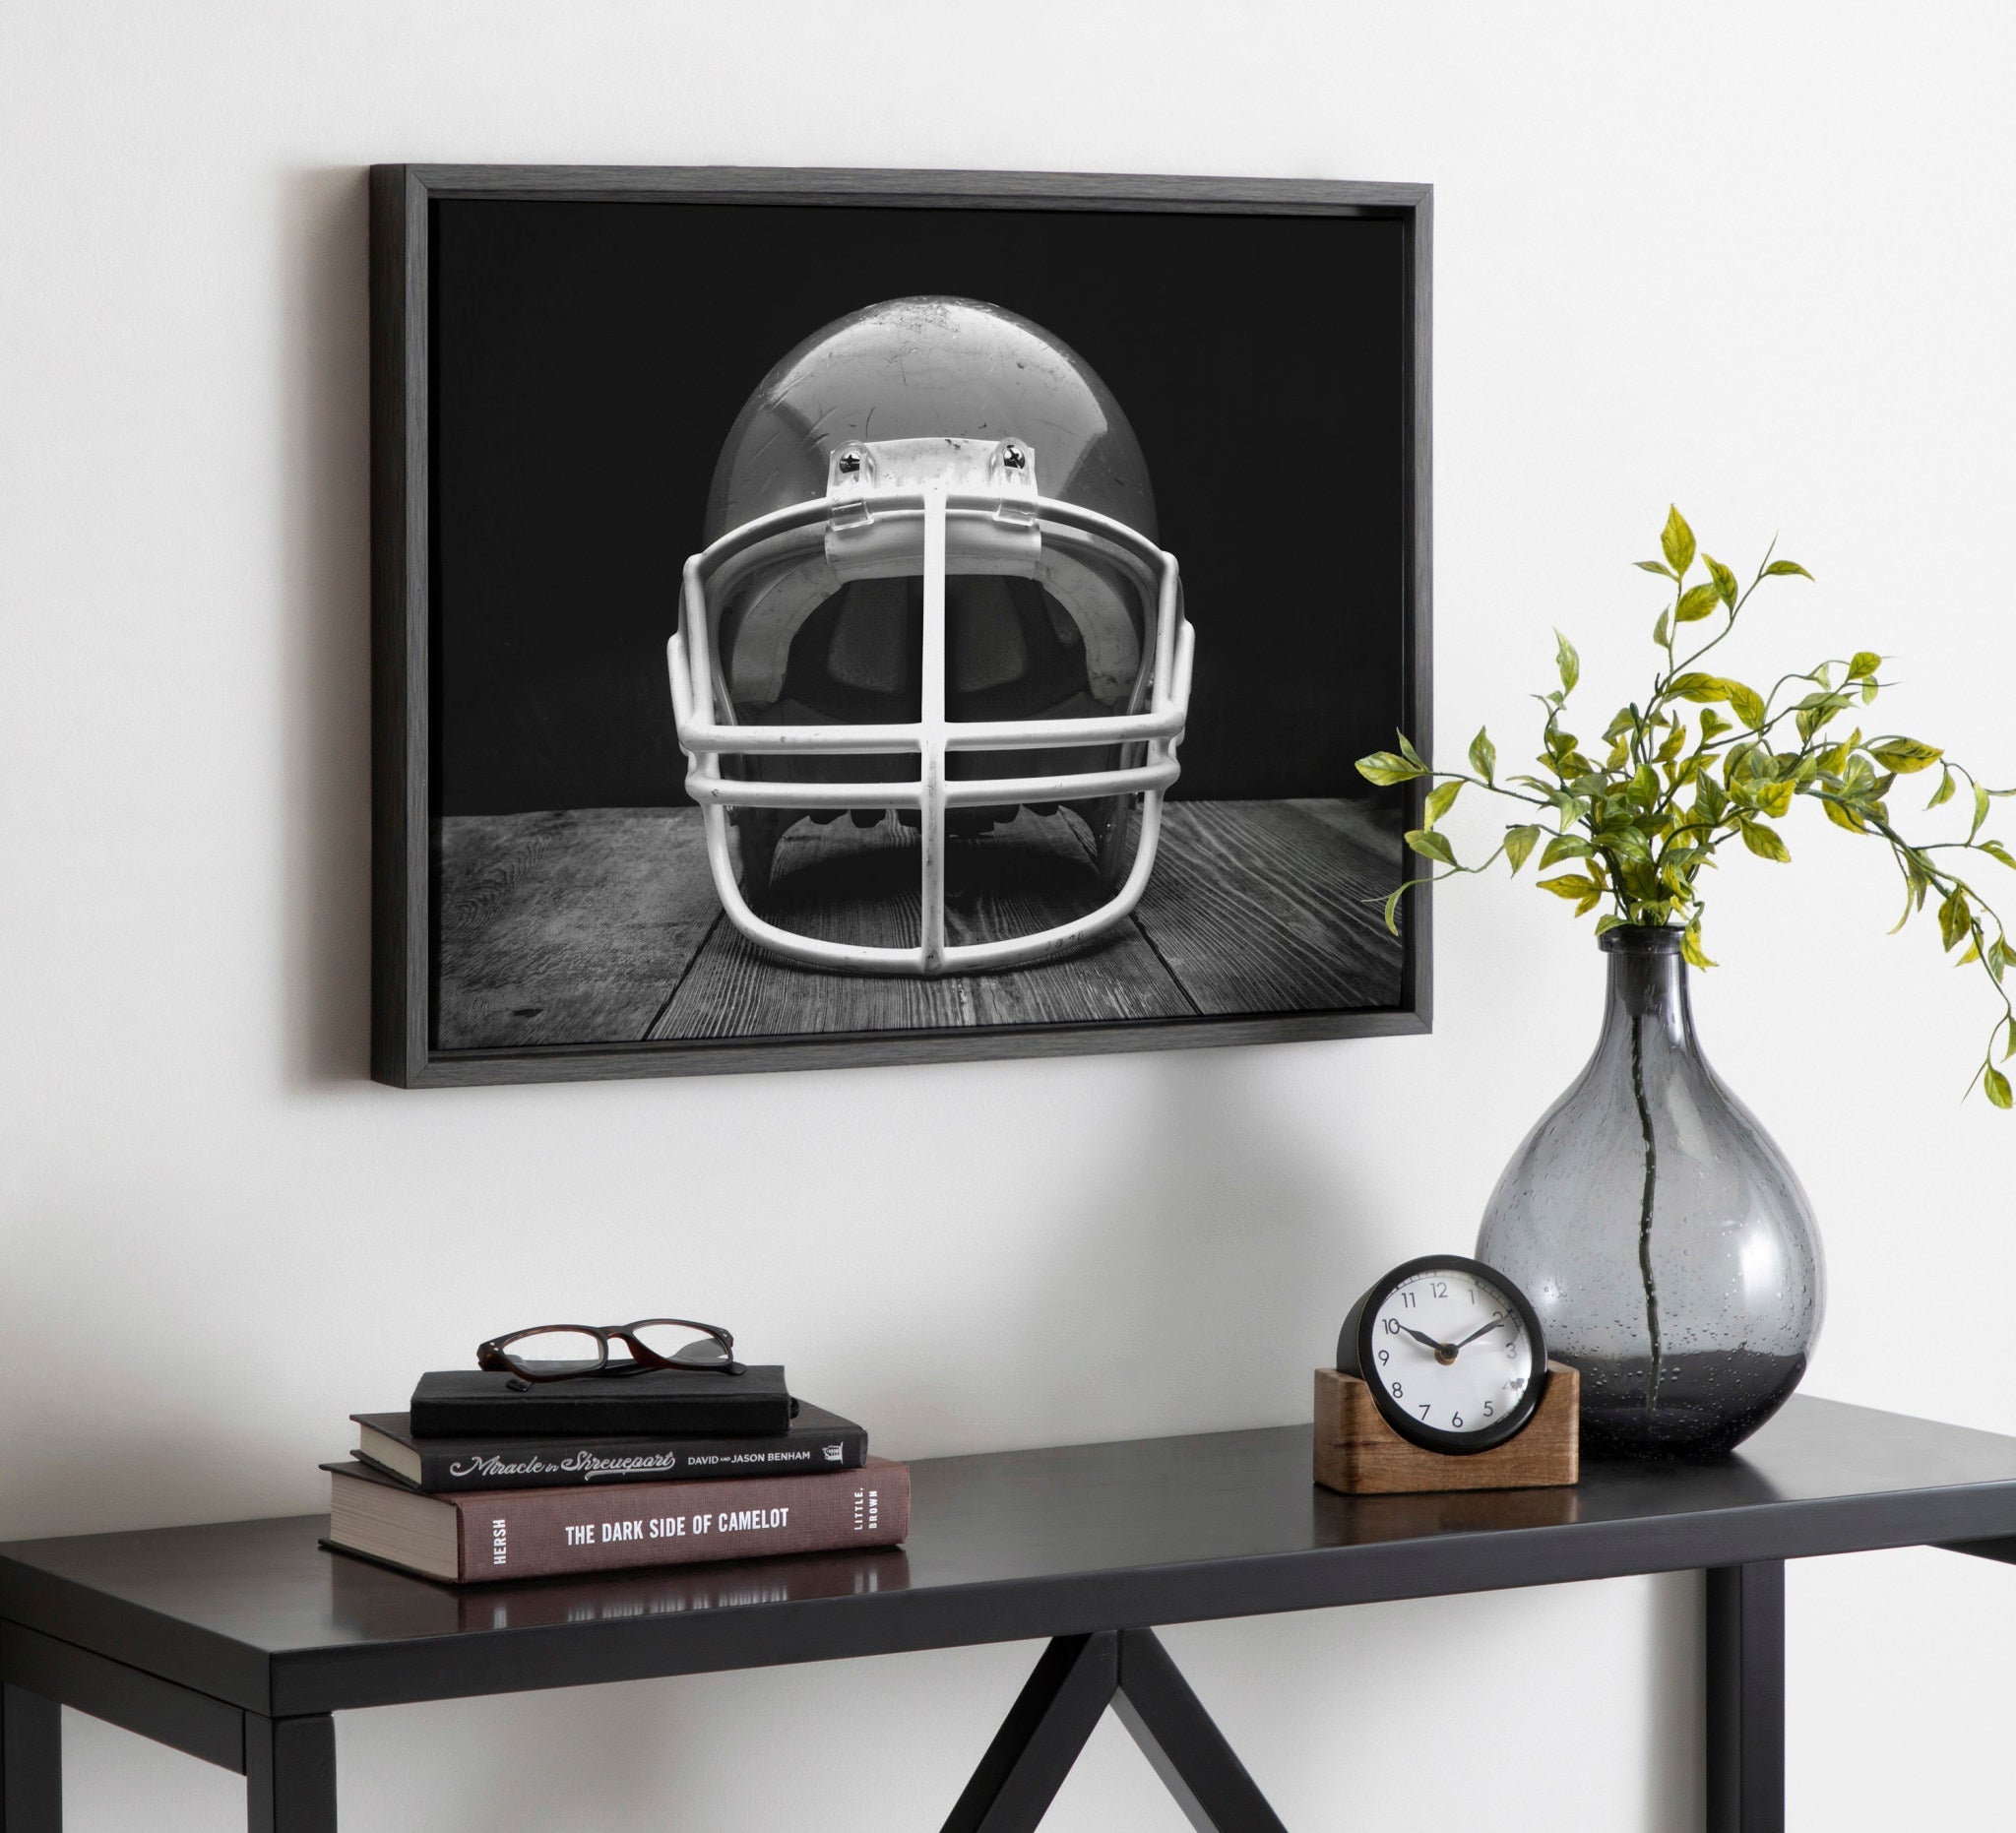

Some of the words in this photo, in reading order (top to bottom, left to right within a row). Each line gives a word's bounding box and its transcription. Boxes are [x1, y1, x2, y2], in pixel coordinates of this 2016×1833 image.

[1430, 1282, 1448, 1298] 12
[1468, 1289, 1476, 1304] 1
[1401, 1292, 1416, 1308] 11
[1382, 1318, 1400, 1334] 10
[1378, 1350, 1389, 1366] 9
[1505, 1343, 1517, 1359] 3
[1391, 1382, 1404, 1398] 8
[1418, 1404, 1431, 1421] 7
[1482, 1401, 1494, 1417] 5
[1451, 1412, 1463, 1427] 6
[449, 1455, 543, 1477] Miracle
[544, 1463, 559, 1473] in
[688, 1456, 719, 1466] DAVID
[730, 1453, 766, 1463] JASON
[767, 1451, 811, 1462] BENHAM
[853, 1487, 864, 1531] LITTLE,
[868, 1490, 878, 1529] BROWN
[565, 1524, 596, 1546] THE
[601, 1520, 644, 1543] DARK
[649, 1516, 686, 1539] SIDE
[692, 1514, 712, 1535] OF
[718, 1507, 789, 1533] CAMELOT
[492, 1519, 507, 1565] HERSH
